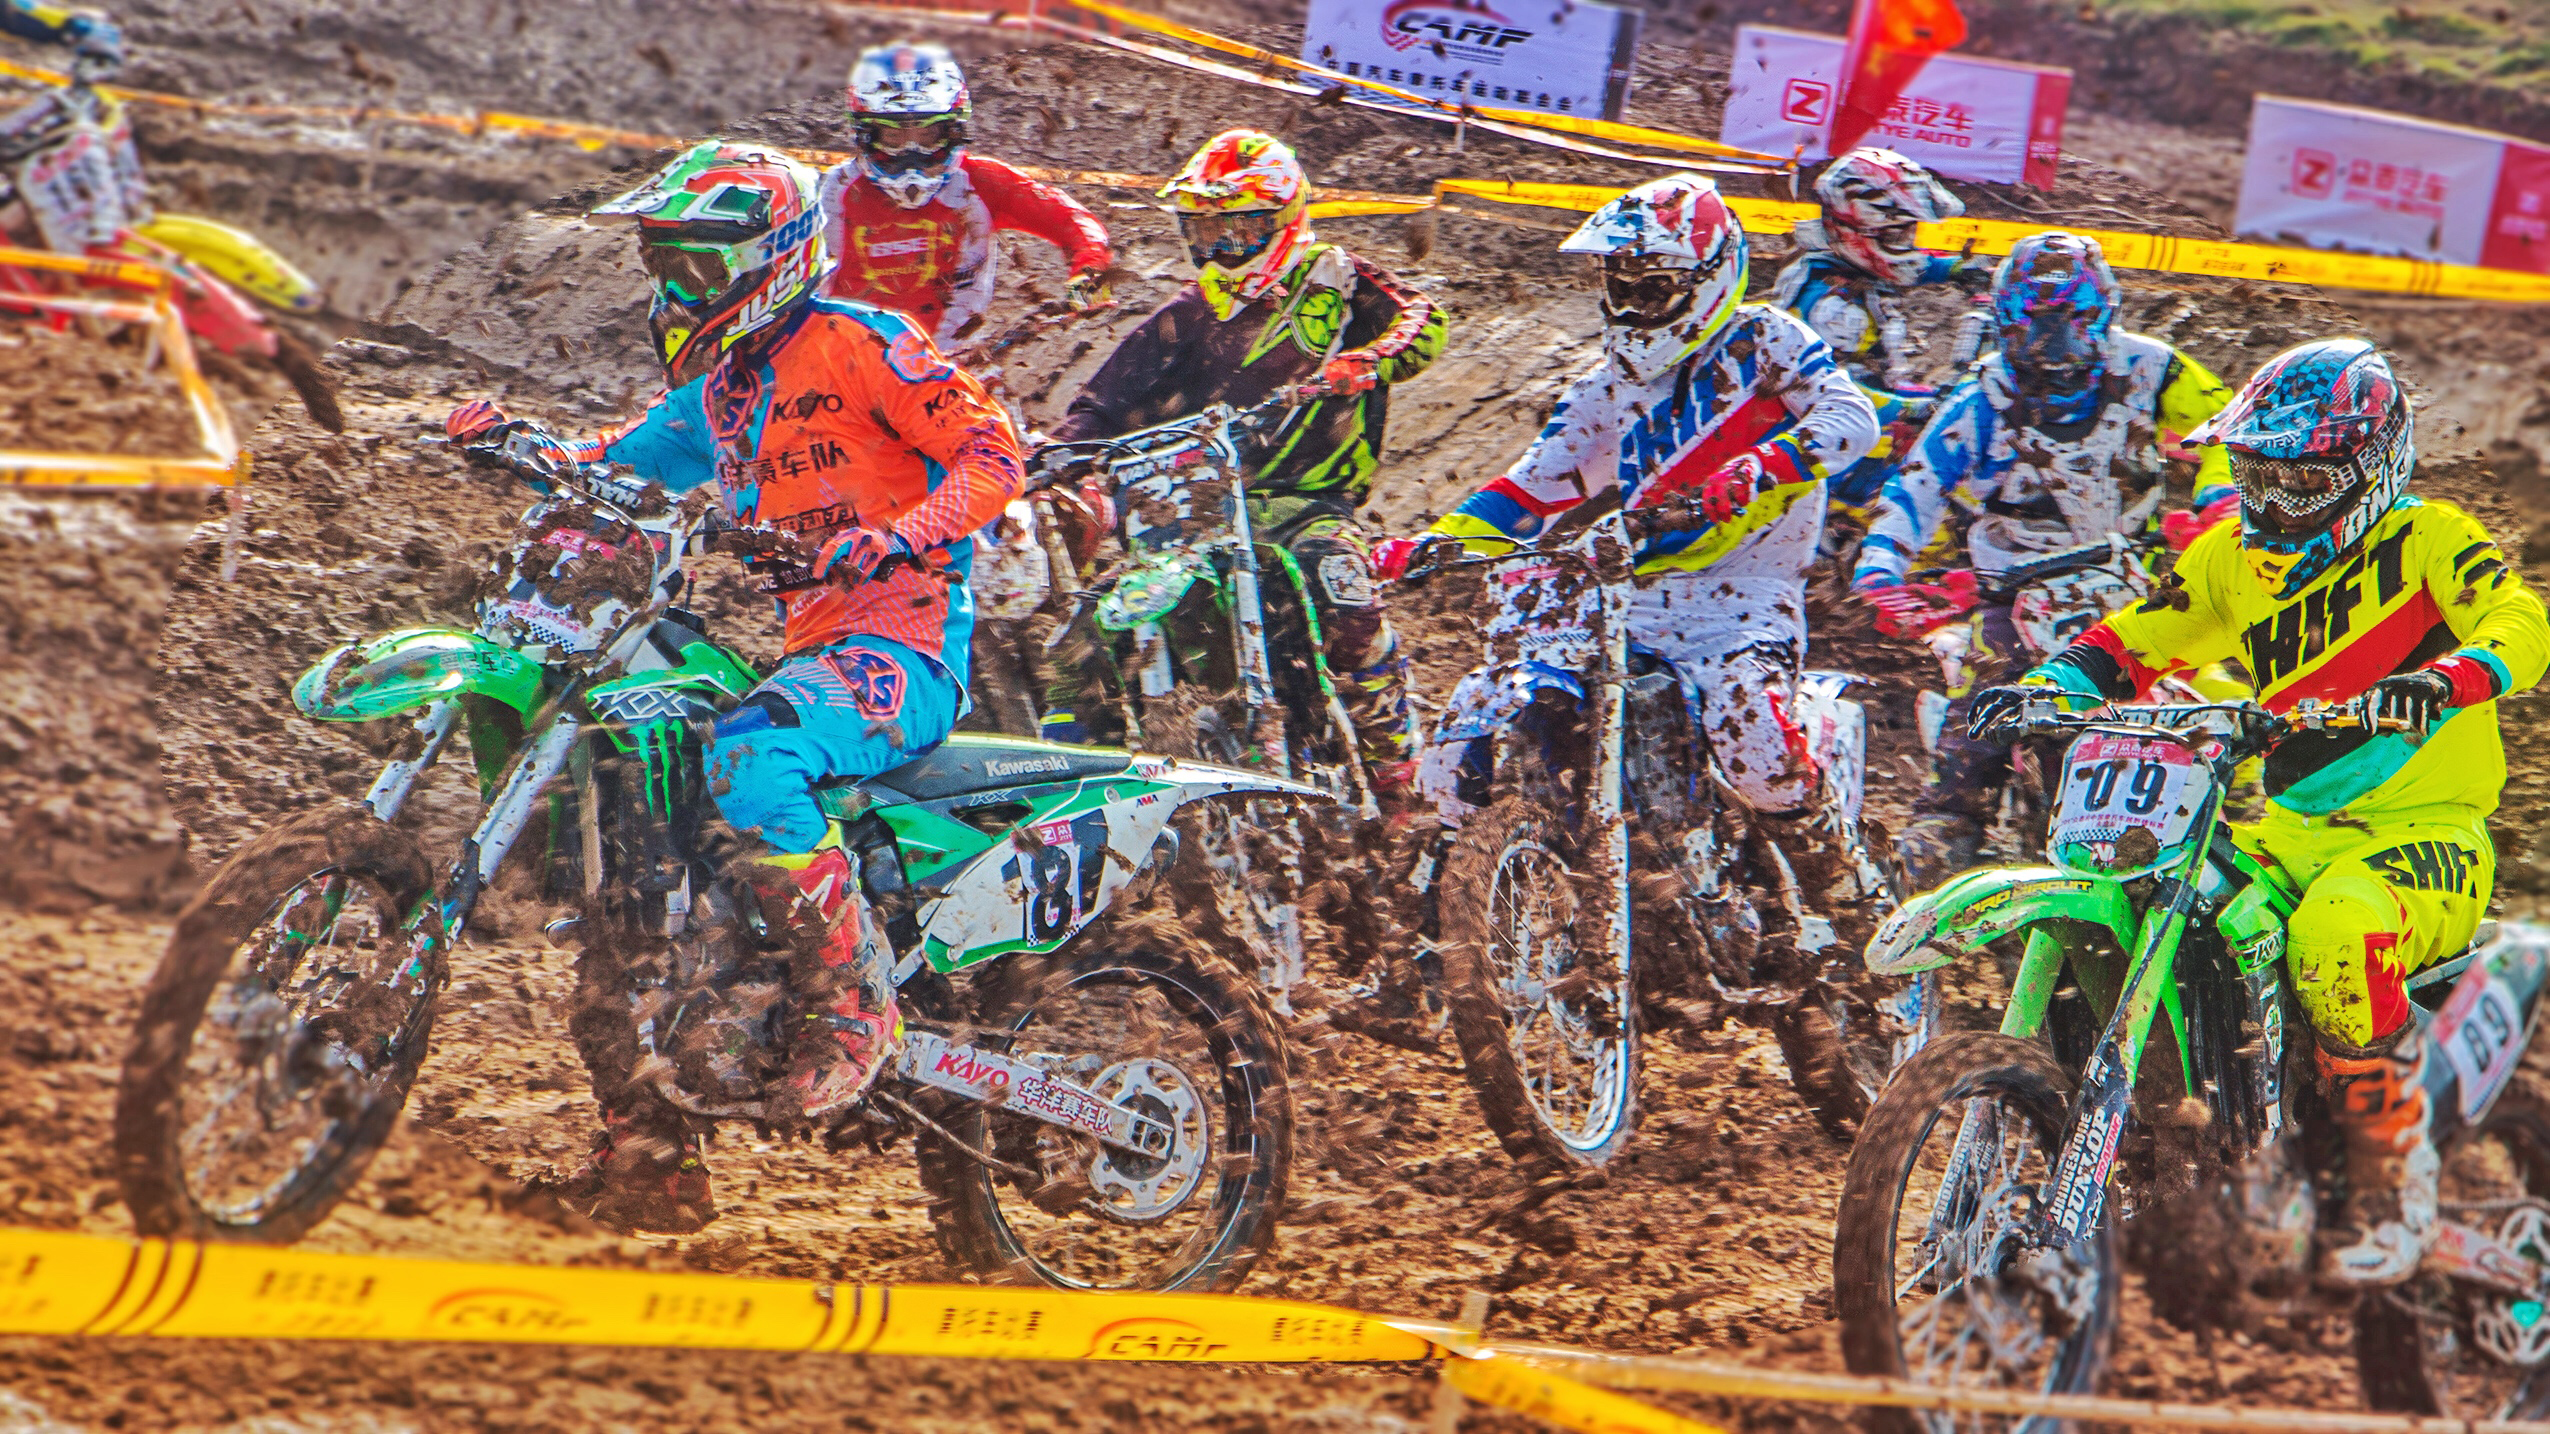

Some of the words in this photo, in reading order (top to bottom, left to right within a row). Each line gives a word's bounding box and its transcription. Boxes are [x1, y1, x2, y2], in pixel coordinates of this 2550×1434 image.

[1396, 12, 1535, 48] CAMF
[1886, 94, 1975, 132] 泰汽车
[1914, 129, 1972, 148] AUTO
[984, 755, 1071, 778] Kawasaki
[2083, 760, 2168, 815] 09
[2362, 841, 2480, 900] SHIFT
[934, 1052, 1011, 1088] KAYO
[1018, 1075, 1115, 1137] 华洋赛车队
[2050, 1111, 2093, 1226] BRIDGESTONE
[2062, 1108, 2107, 1238] DUNLOP
[2095, 1112, 2124, 1187] BRAKING
